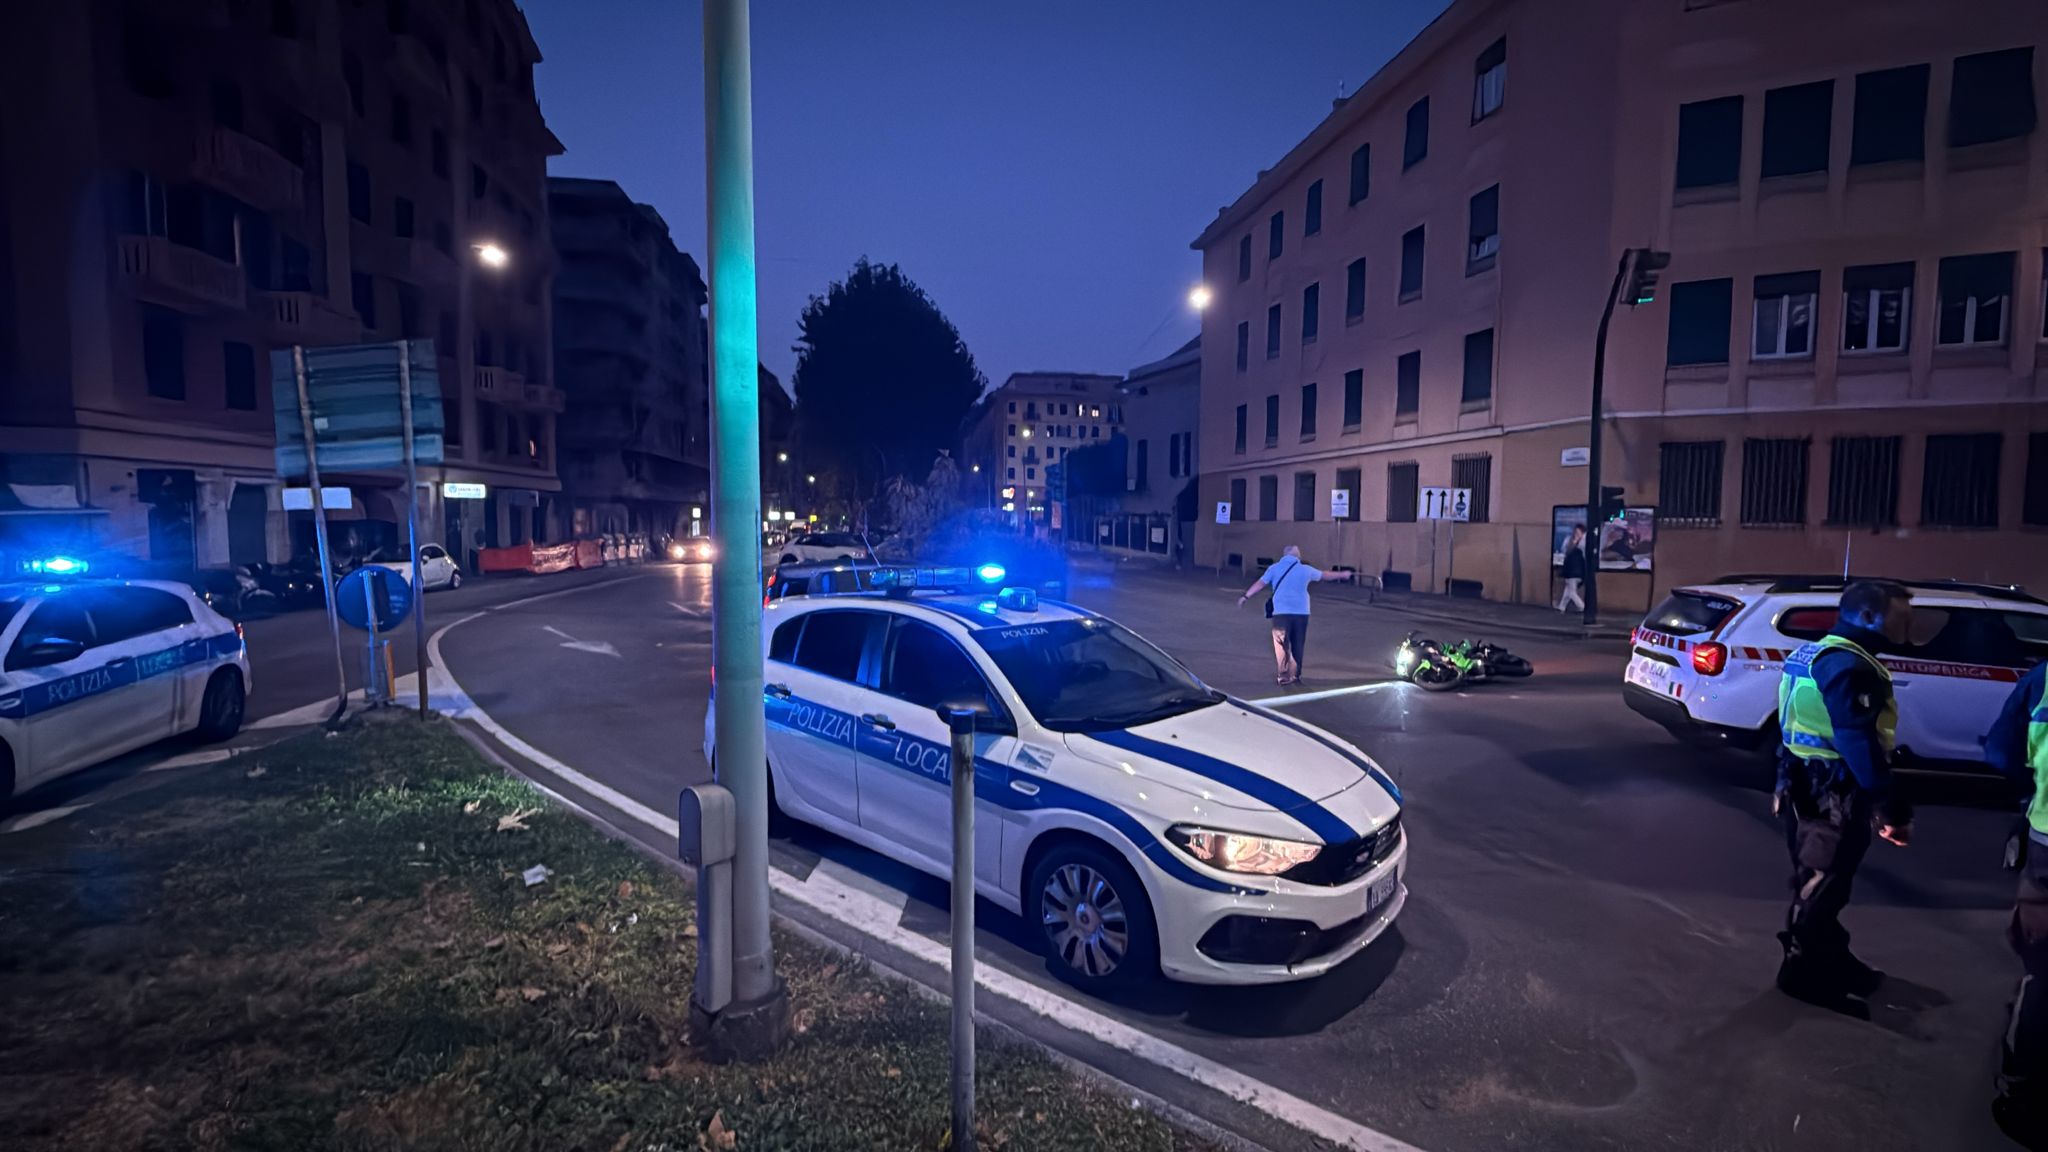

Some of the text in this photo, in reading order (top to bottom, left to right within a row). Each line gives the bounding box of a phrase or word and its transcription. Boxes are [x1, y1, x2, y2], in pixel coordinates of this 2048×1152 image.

[1000, 627, 1049, 639] POLIZIA
[1885, 661, 1991, 678] AUTOMEDICA
[48, 669, 112, 703] POLIZIA
[787, 702, 952, 783] POLIZIA LOCA
